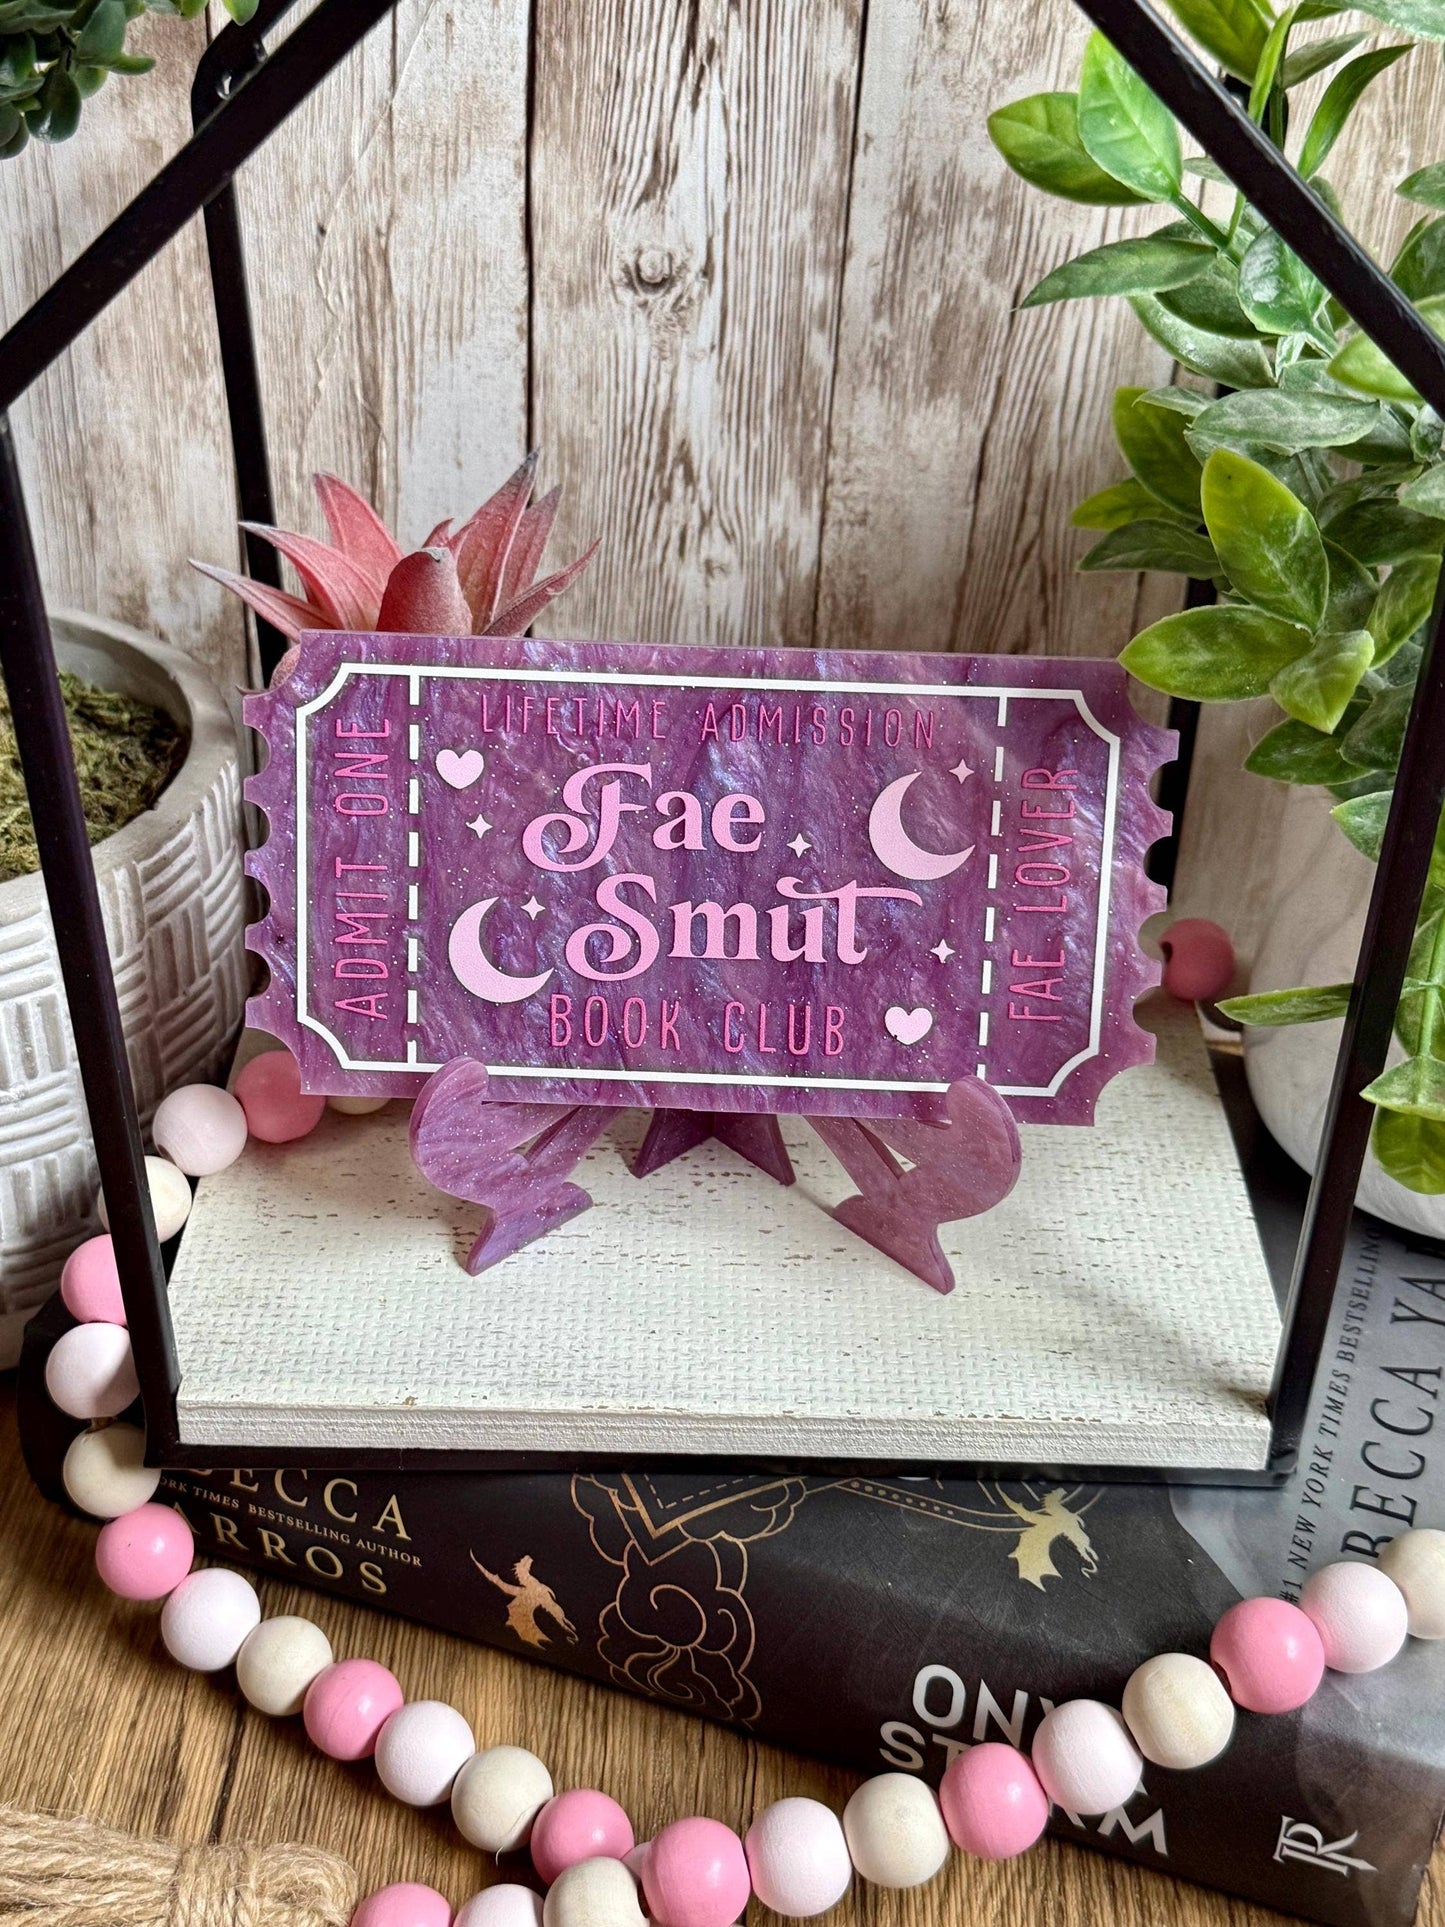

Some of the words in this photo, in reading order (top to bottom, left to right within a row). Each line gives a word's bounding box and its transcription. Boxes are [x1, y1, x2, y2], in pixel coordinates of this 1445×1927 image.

[481, 694, 667, 740] LIFETIME
[701, 703, 934, 749] ADMISSION
[335, 718, 390, 816] ONE
[522, 762, 766, 873] Fae
[1014, 768, 1079, 912] LOVER
[335, 856, 389, 1020] ADMIT
[565, 872, 923, 982] Smut
[1009, 948, 1066, 1022] FAE
[550, 993, 681, 1051] BOOK
[723, 1001, 845, 1056] CLUB
[1319, 1369, 1350, 1437] TIMES
[1301, 1445, 1334, 1508] YORK
[193, 1486, 240, 1509] TIMES
[248, 1503, 350, 1545] BESTSELLING
[356, 1538, 423, 1568] AUTHOR
[1287, 1514, 1317, 1570] NEW
